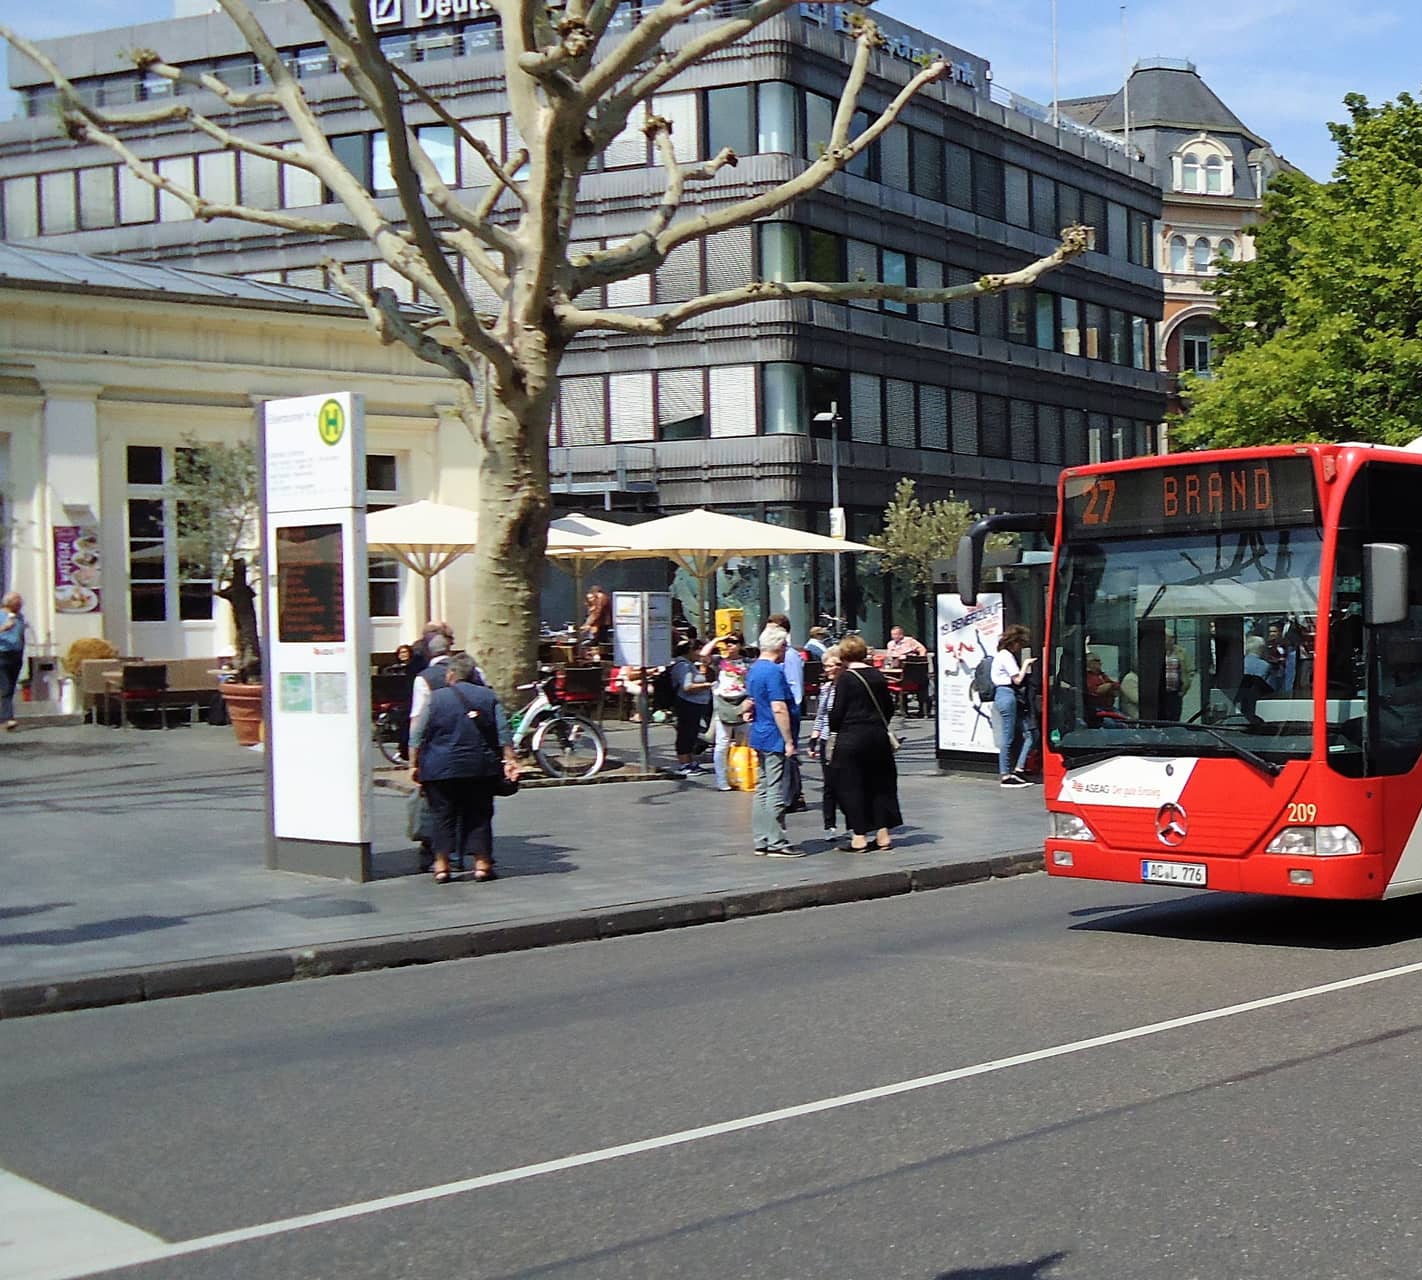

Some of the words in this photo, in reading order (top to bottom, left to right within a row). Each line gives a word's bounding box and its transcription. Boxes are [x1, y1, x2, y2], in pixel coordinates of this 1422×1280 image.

[1082, 479, 1116, 525] 27
[1163, 467, 1272, 517] BRAND
[1085, 783, 1110, 794] ASEAG
[1287, 803, 1318, 823] 209
[1151, 864, 1164, 879] AC
[1182, 867, 1202, 882] 776
